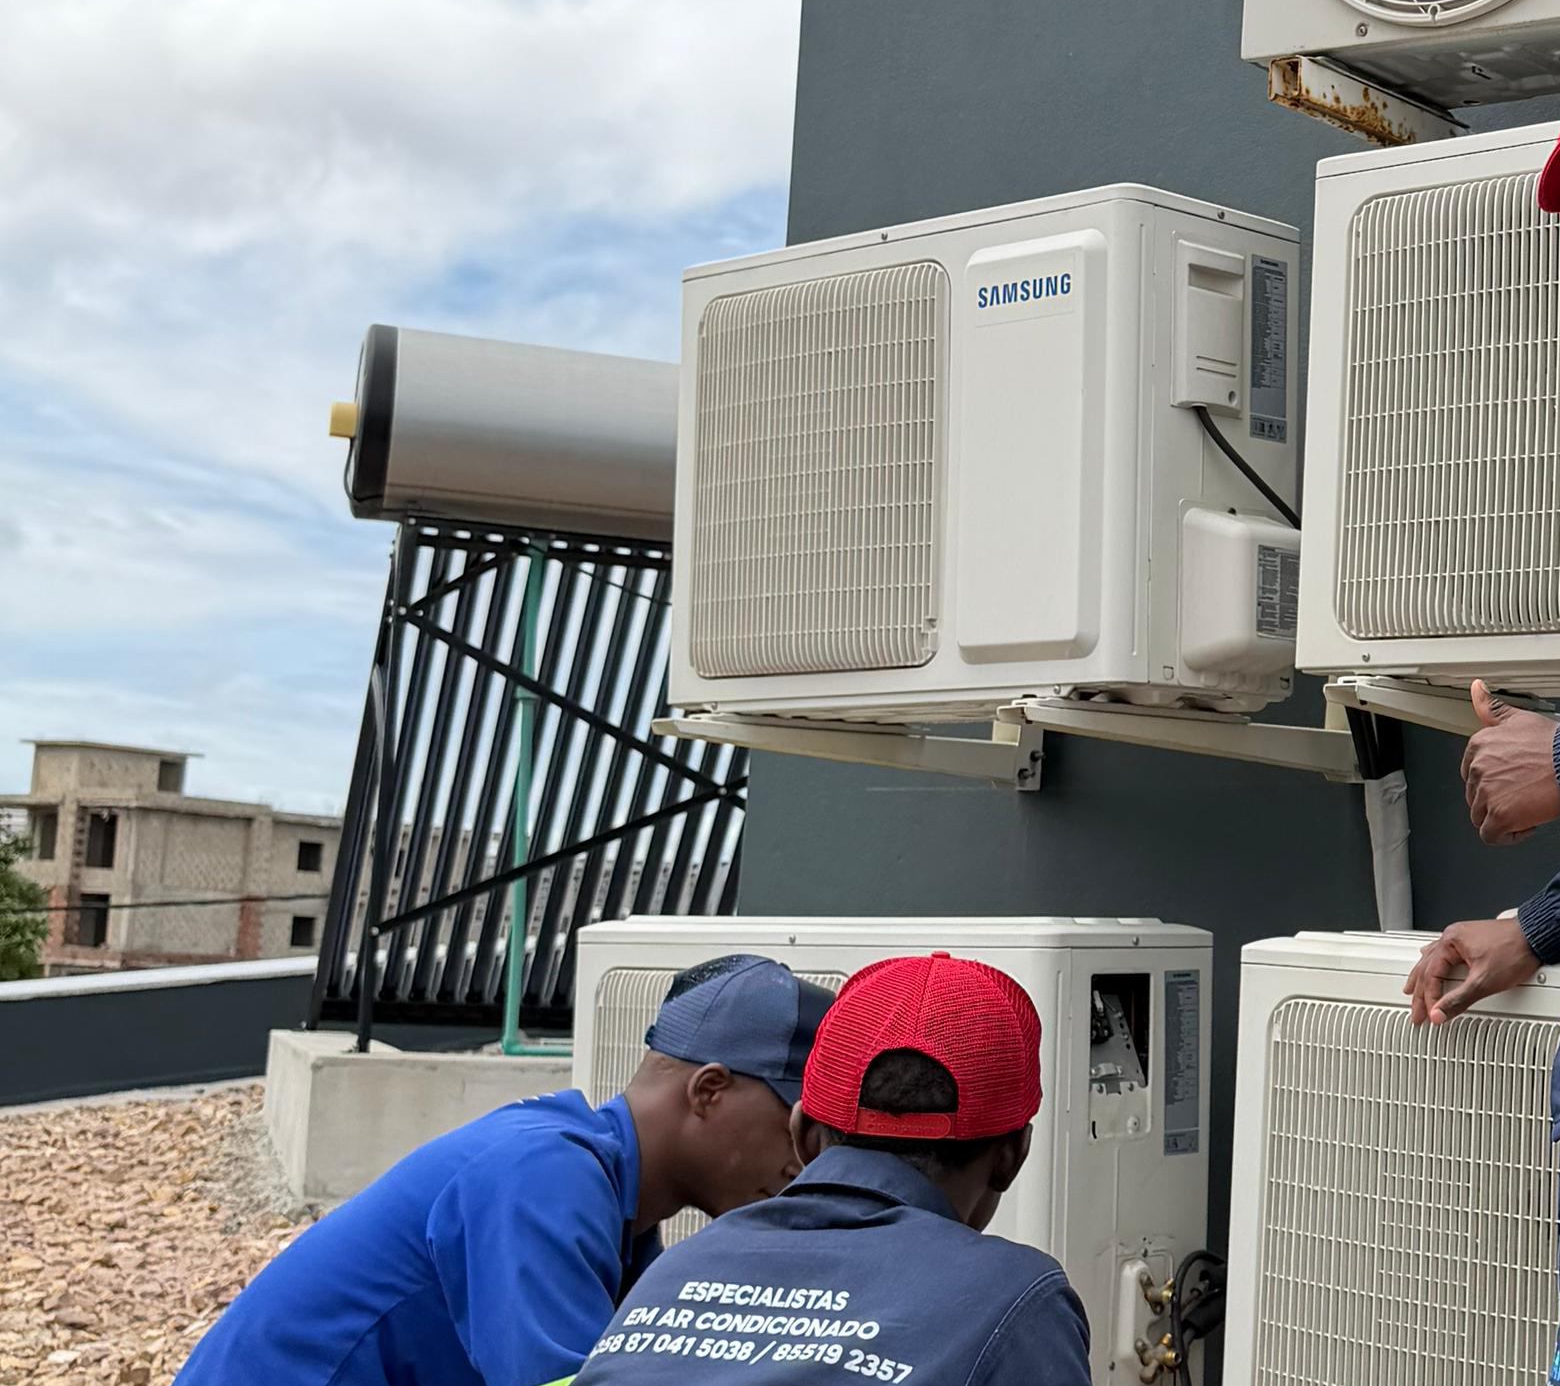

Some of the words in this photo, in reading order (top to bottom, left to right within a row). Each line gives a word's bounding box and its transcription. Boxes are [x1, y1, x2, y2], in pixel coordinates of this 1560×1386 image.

[978, 272, 1071, 309] SAMSUNG
[678, 1281, 850, 1311] ESPECIALISTAS
[623, 1306, 658, 1326] EM
[656, 1307, 695, 1329] AR
[695, 1312, 880, 1340] CONDICIONADO
[624, 1332, 655, 1352] 87
[653, 1333, 697, 1356] 041
[695, 1338, 756, 1361] 5038
[771, 1344, 844, 1364] 85519
[843, 1349, 914, 1385] 2357
